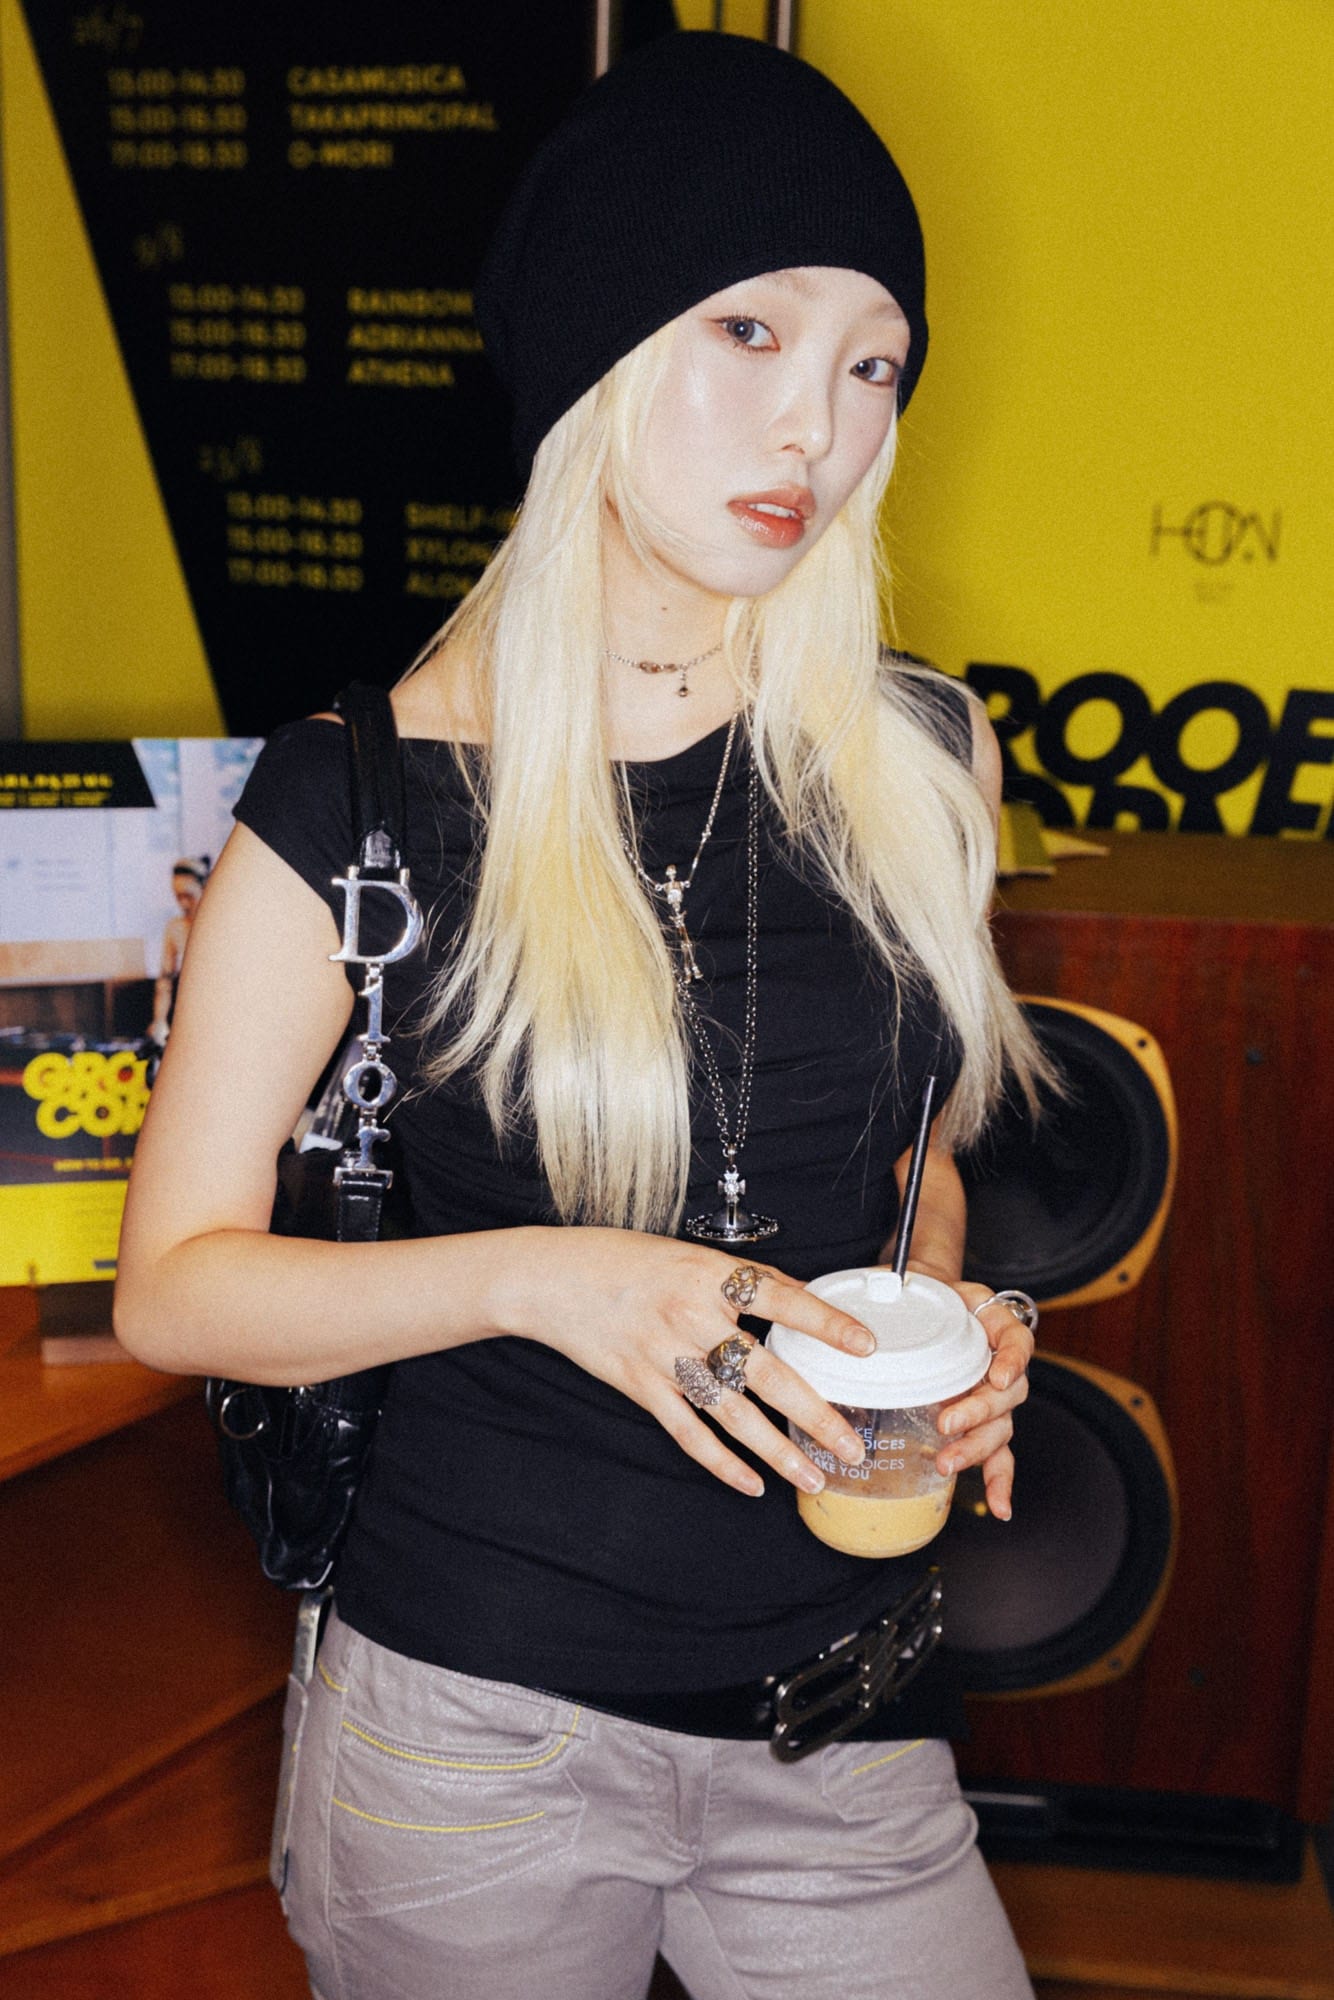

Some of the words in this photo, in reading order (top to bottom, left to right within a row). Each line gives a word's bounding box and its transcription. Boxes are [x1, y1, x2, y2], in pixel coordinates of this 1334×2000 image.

[289, 66, 464, 93] CASAMUSICA
[349, 360, 453, 385] ATHENA
[328, 876, 425, 1171] Dior
[863, 1439, 906, 1451] OICES
[840, 1466, 870, 1481] YOU
